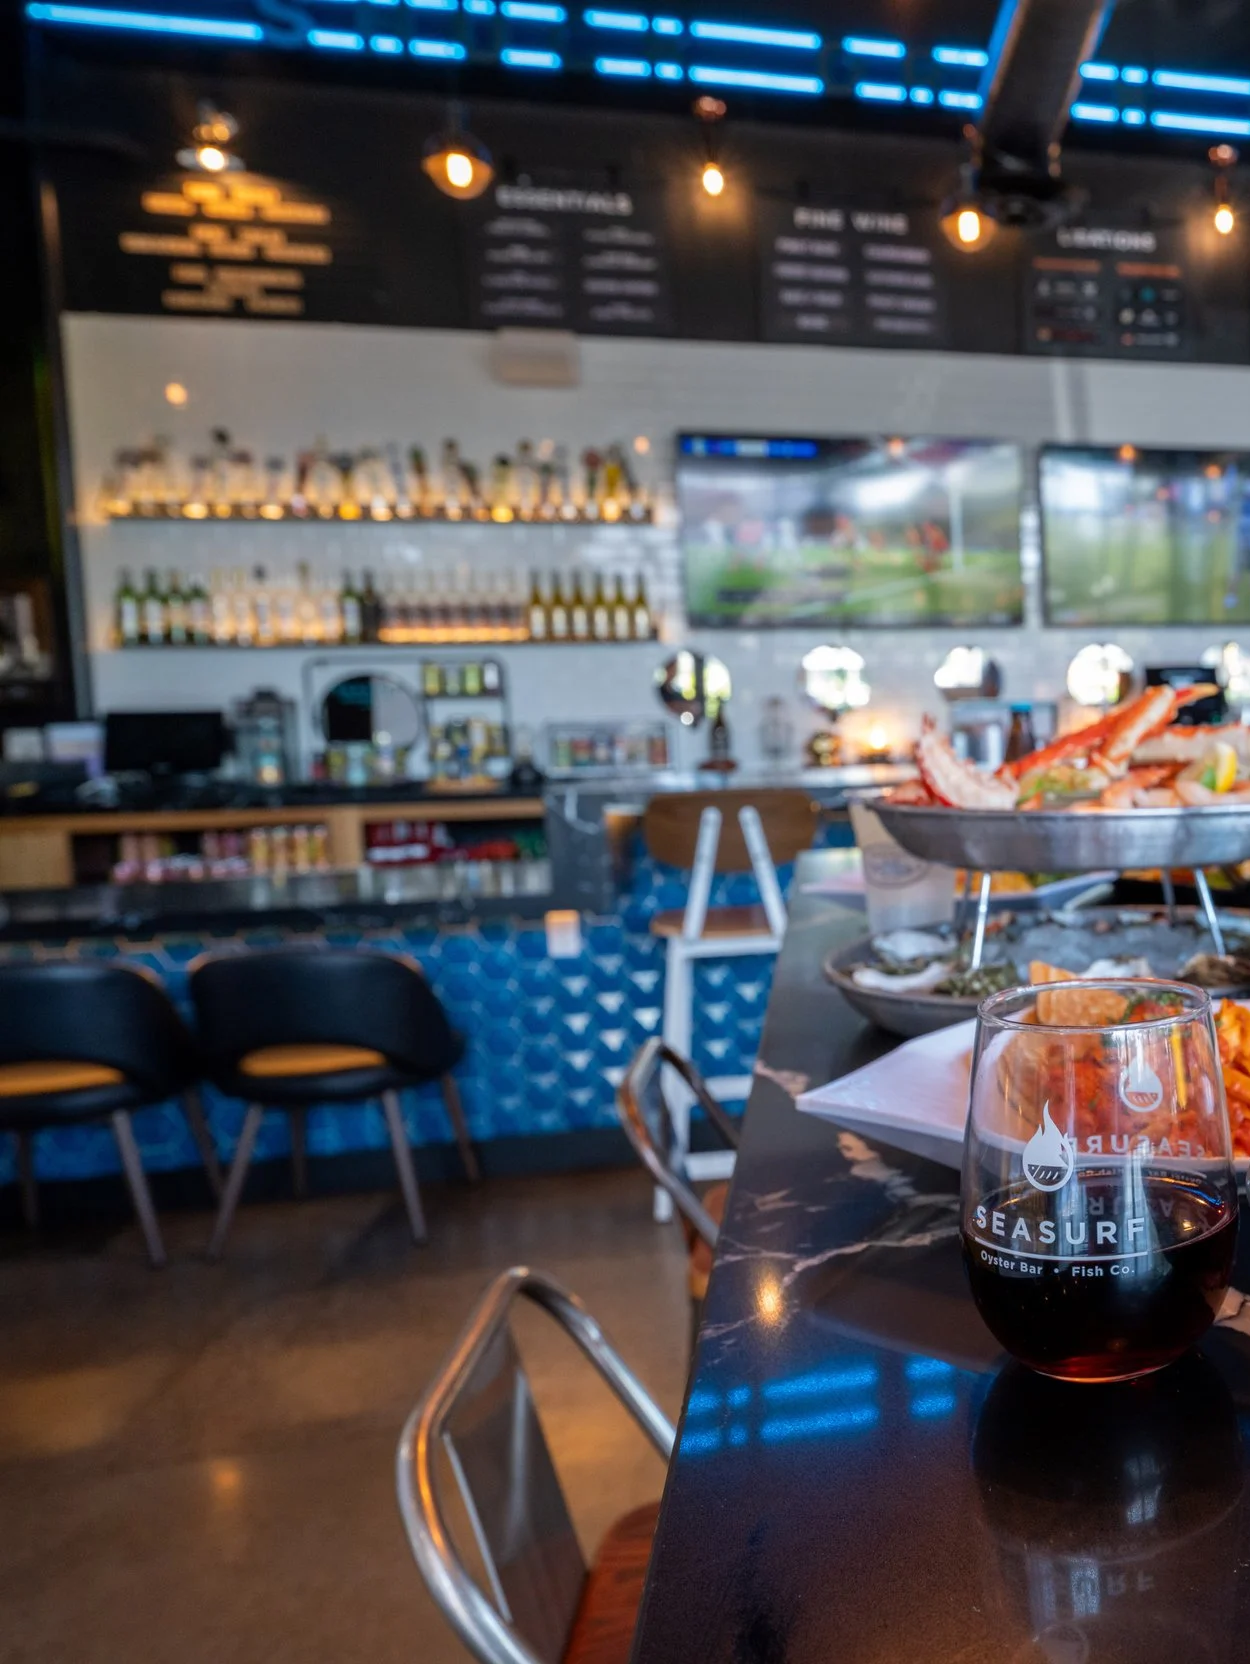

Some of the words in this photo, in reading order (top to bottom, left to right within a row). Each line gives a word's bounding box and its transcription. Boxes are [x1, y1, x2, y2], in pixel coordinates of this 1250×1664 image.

[976, 1205, 1145, 1245] SEASURF
[980, 1250, 1016, 1271] Oyster
[1020, 1261, 1043, 1275] Bar
[1071, 1265, 1103, 1277] Fish
[1110, 1264, 1135, 1275] Co.
